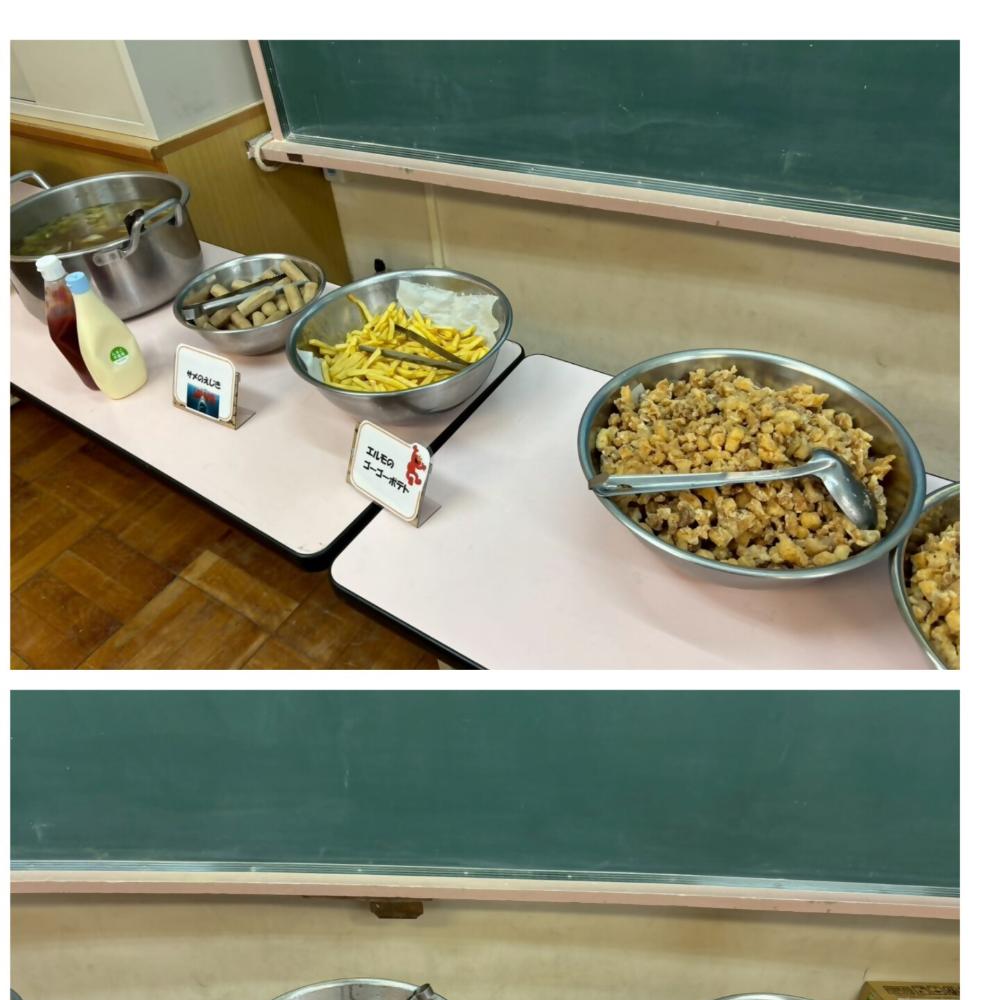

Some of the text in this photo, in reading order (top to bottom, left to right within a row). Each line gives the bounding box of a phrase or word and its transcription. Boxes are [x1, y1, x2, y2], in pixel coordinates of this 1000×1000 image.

[187, 370, 221, 390] サメのえじき
[366, 446, 395, 468] エルモの
